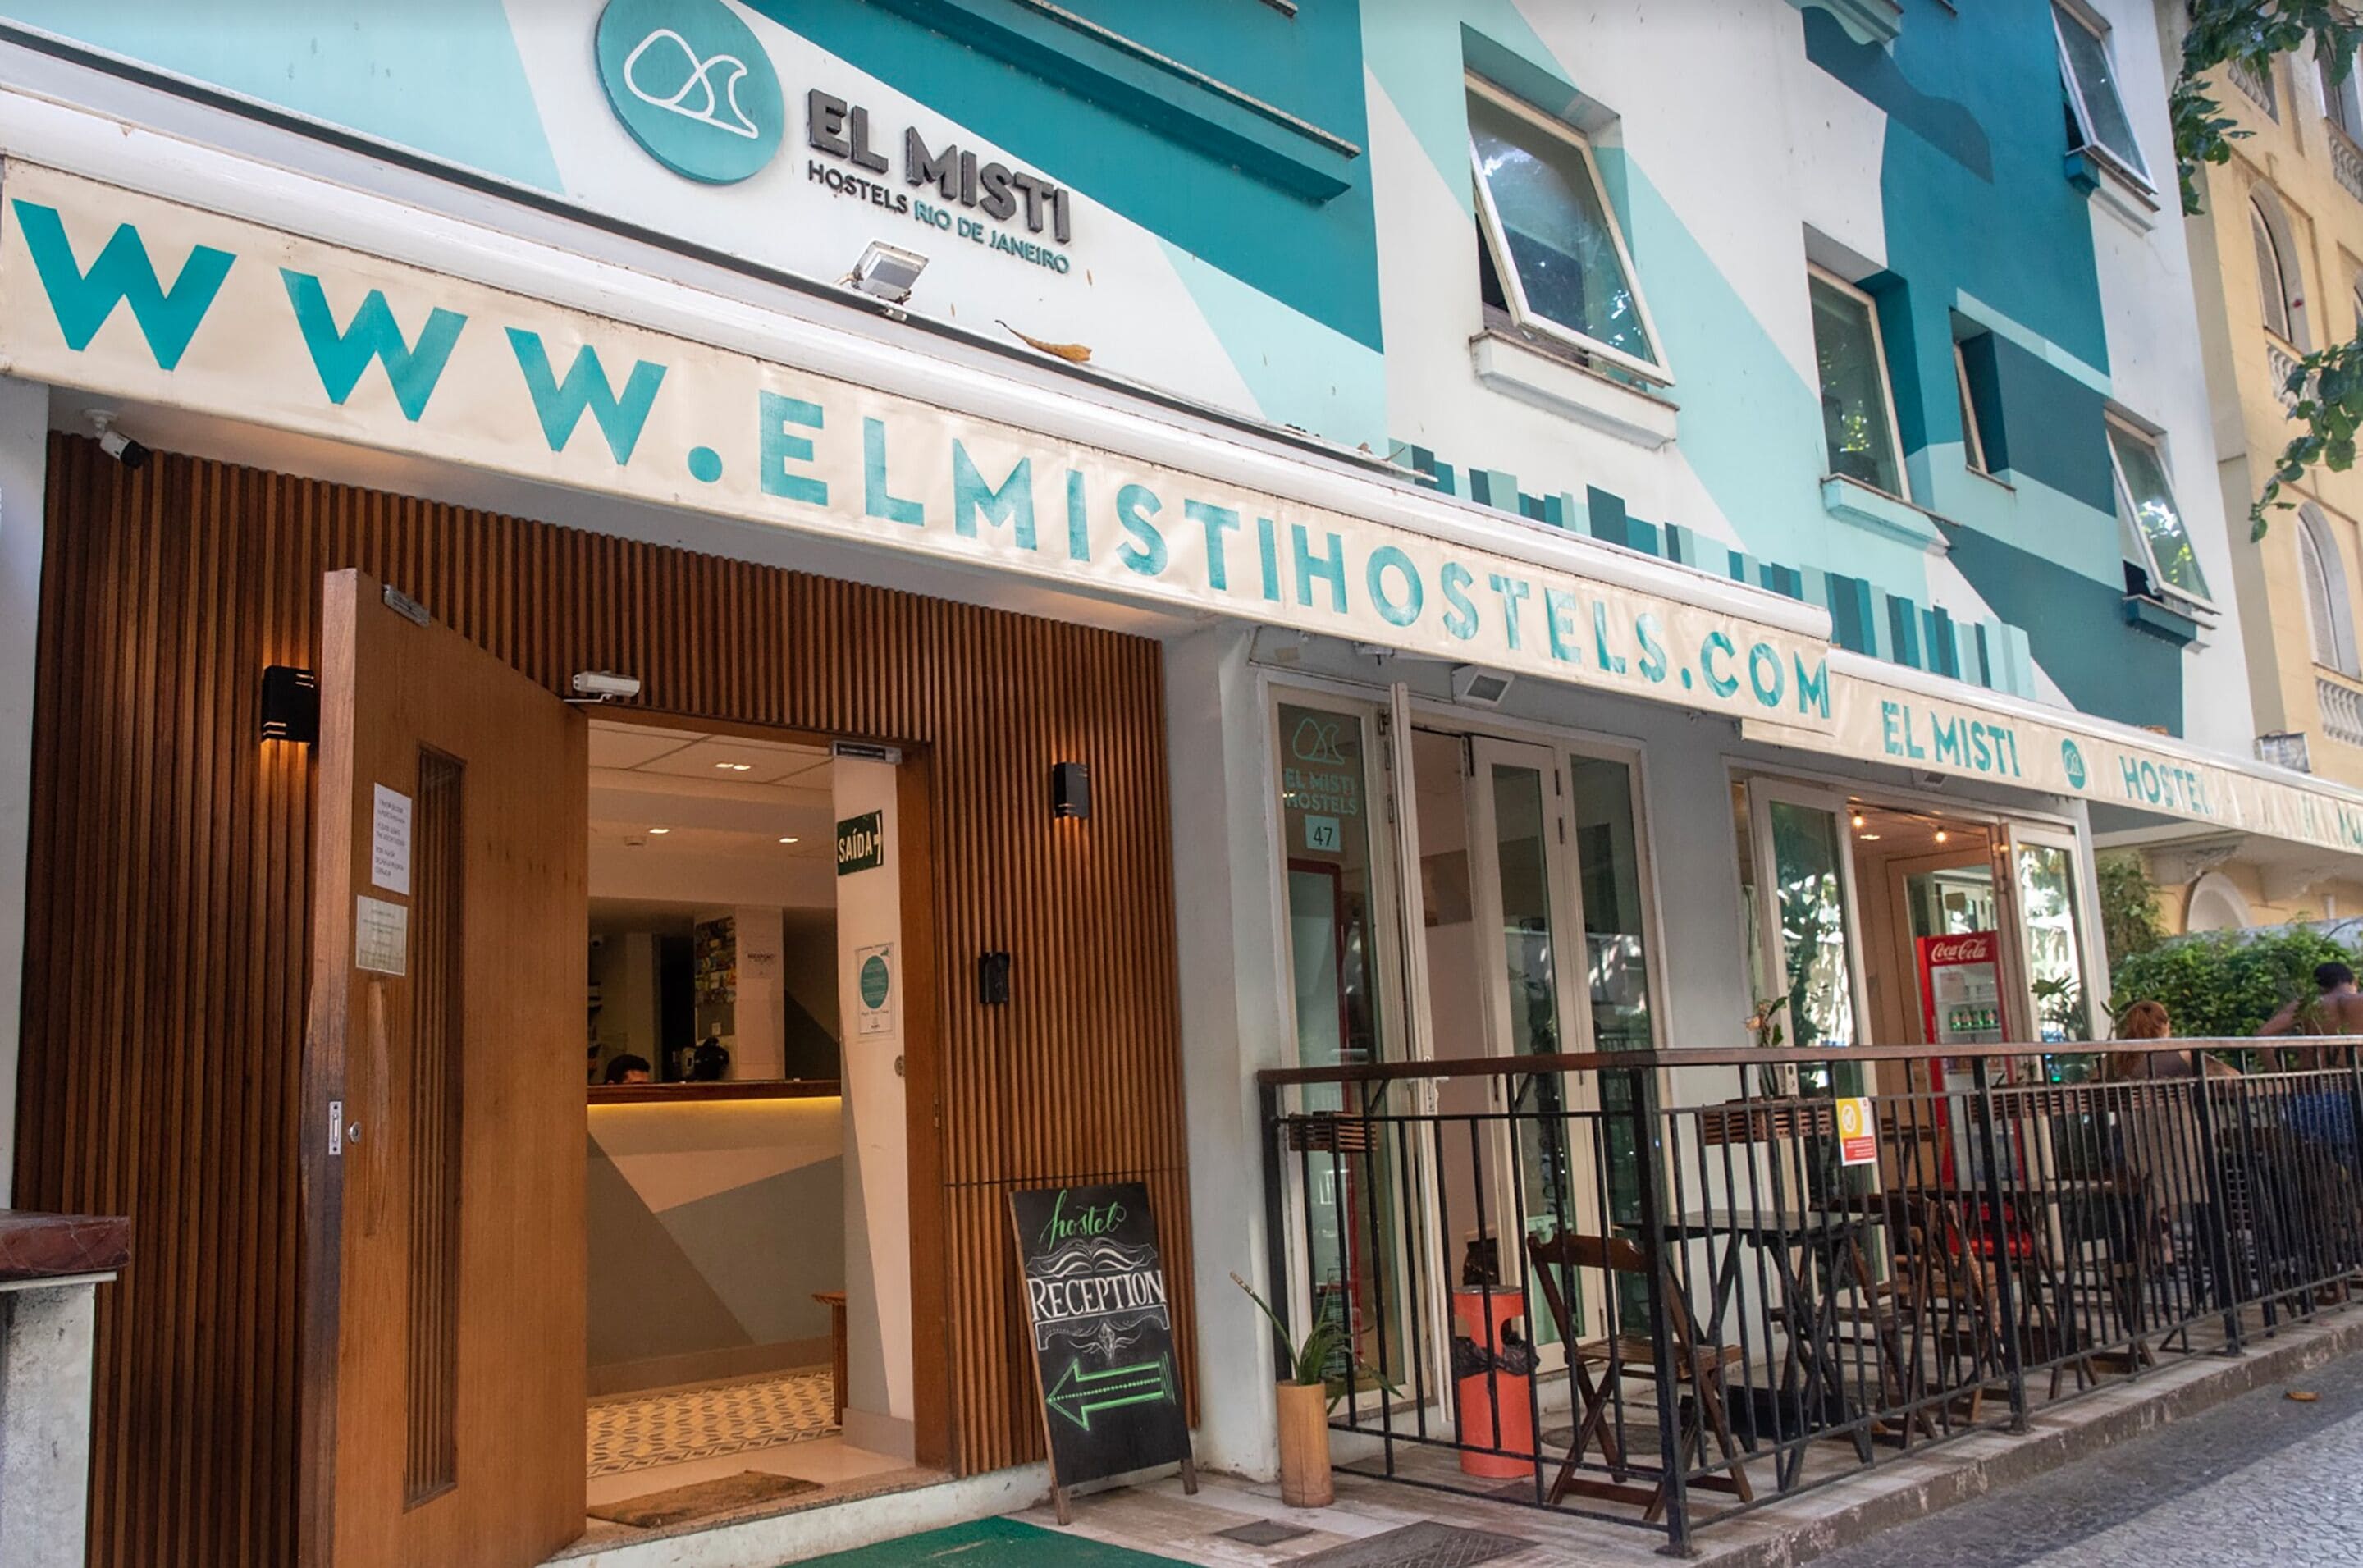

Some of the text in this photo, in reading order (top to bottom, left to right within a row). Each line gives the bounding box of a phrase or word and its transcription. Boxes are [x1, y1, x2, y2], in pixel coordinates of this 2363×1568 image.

[807, 88, 1071, 245] EL MISTI
[808, 159, 1070, 274] HOSTELS RIO DE JANEIRO
[1881, 700, 1925, 761] EL
[1930, 711, 2022, 778] MISTI
[1285, 767, 1354, 795] EL MISTI
[1286, 790, 1358, 816] HOSTELS
[839, 828, 873, 863] SAÍDA
[1313, 826, 1333, 847] 47
[1039, 1189, 1127, 1253] hostel
[1026, 1269, 1168, 1322] RECEPTION
